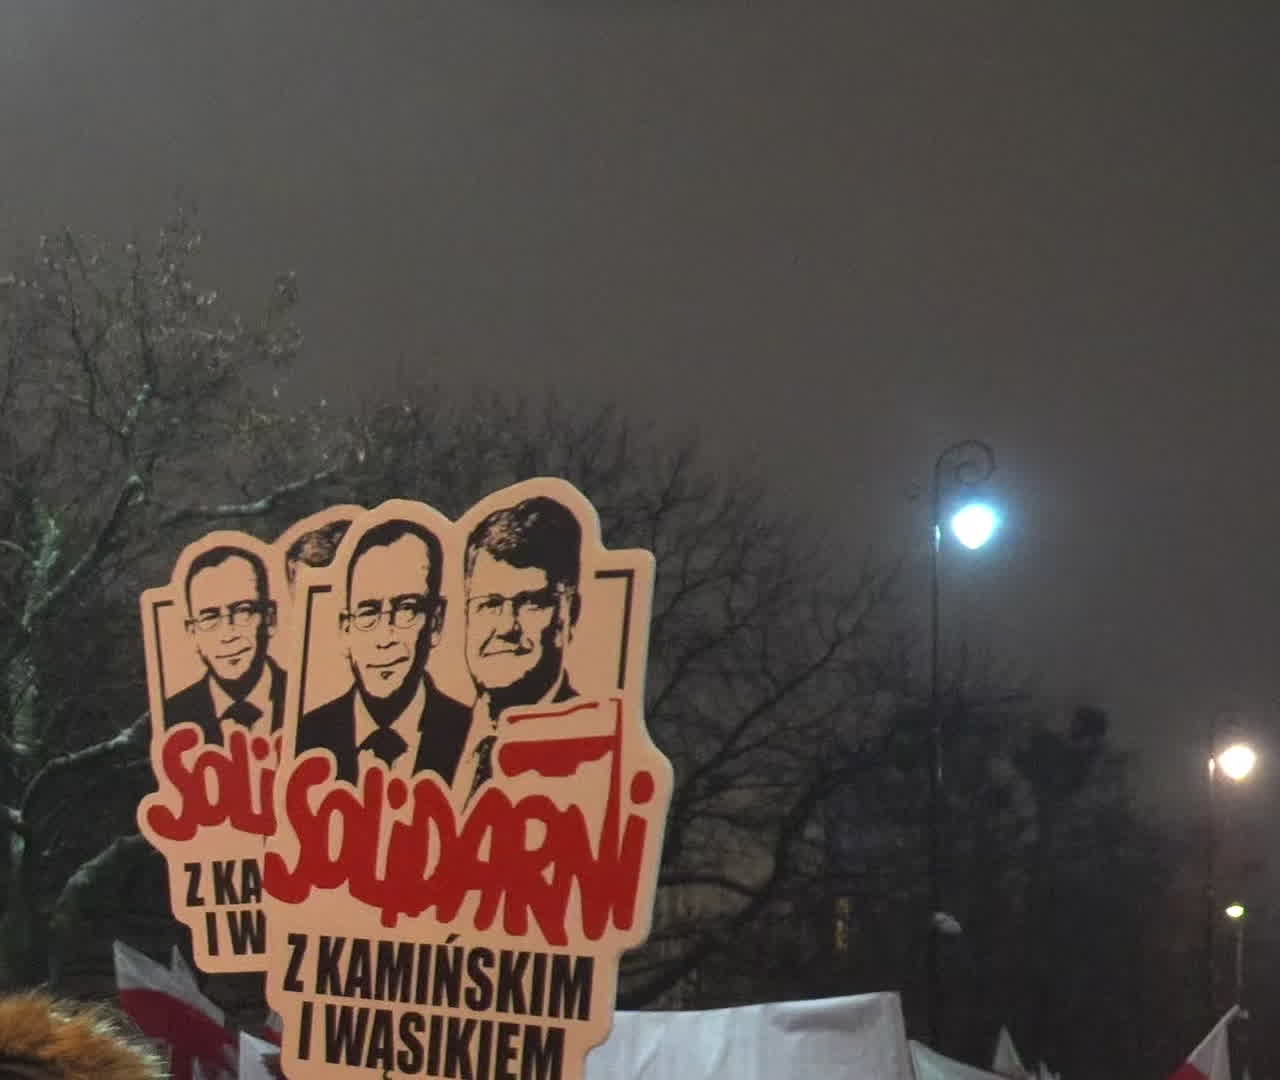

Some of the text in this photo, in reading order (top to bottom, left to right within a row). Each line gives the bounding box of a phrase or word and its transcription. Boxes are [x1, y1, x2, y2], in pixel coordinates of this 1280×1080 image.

[184, 862, 205, 907] Z
[206, 911, 219, 956] I
[282, 933, 595, 1022] Z KAMIŃSKIM
[297, 1000, 313, 1062] I
